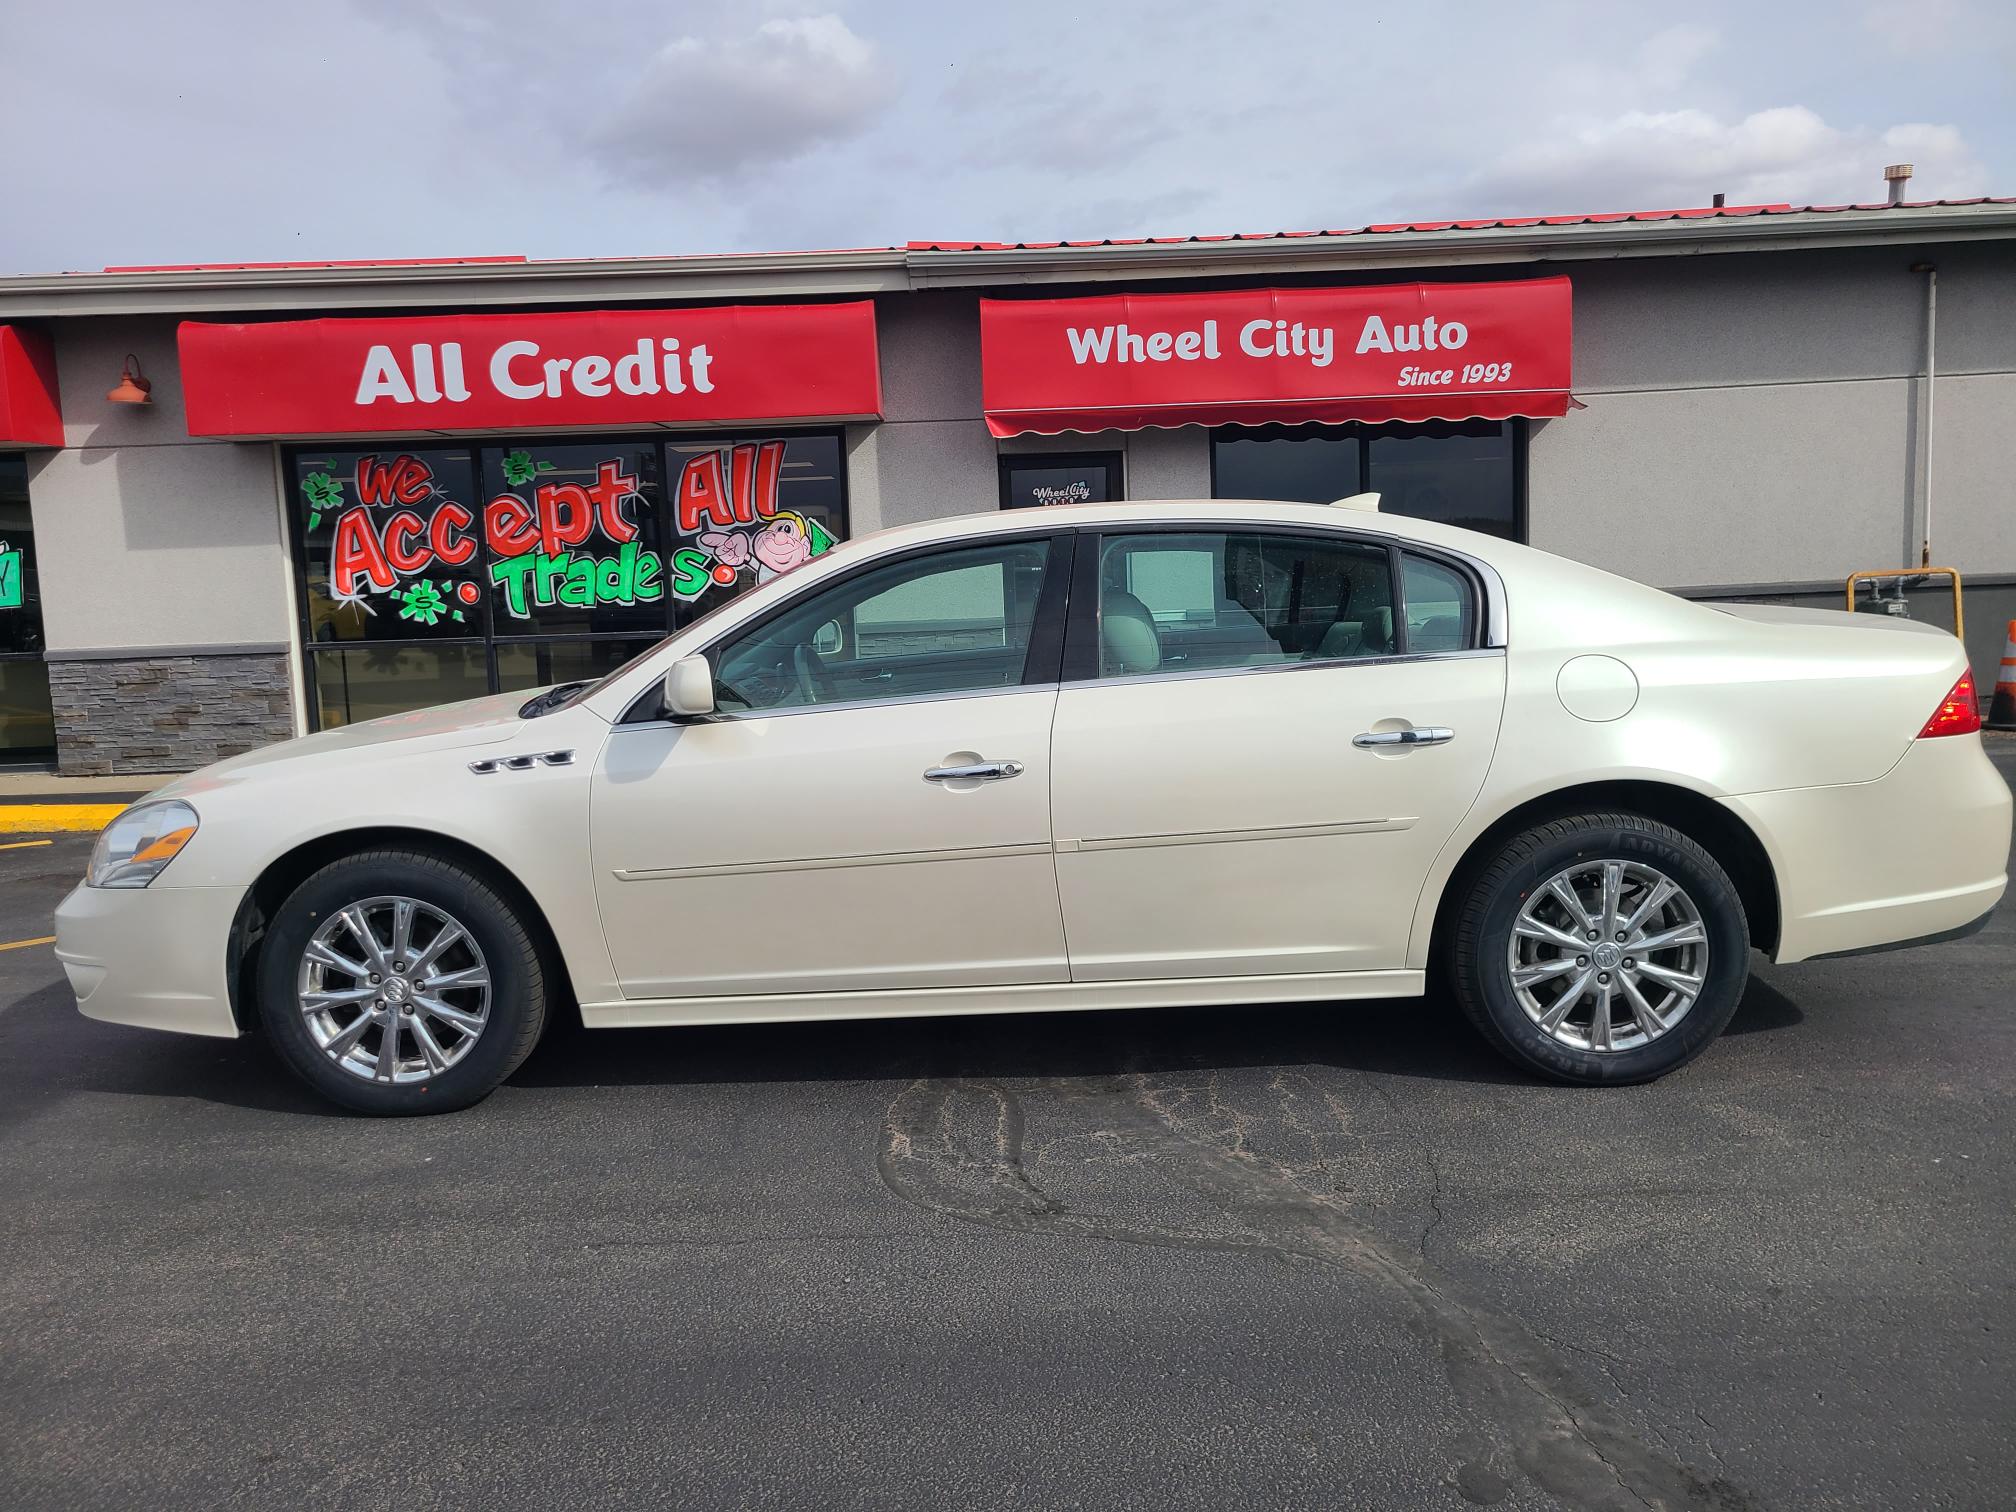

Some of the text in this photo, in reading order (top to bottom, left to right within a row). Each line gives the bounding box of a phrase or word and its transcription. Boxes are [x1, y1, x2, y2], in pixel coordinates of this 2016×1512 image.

[1067, 315, 1468, 367] Wheel City Auto
[355, 338, 714, 405] All Credit
[1397, 363, 1511, 387] Since 1993
[356, 455, 434, 507] We
[1032, 482, 1090, 499] Wheel City
[1044, 497, 1074, 506] AUTO
[330, 440, 788, 600] Accept All
[490, 540, 713, 619] Trades
